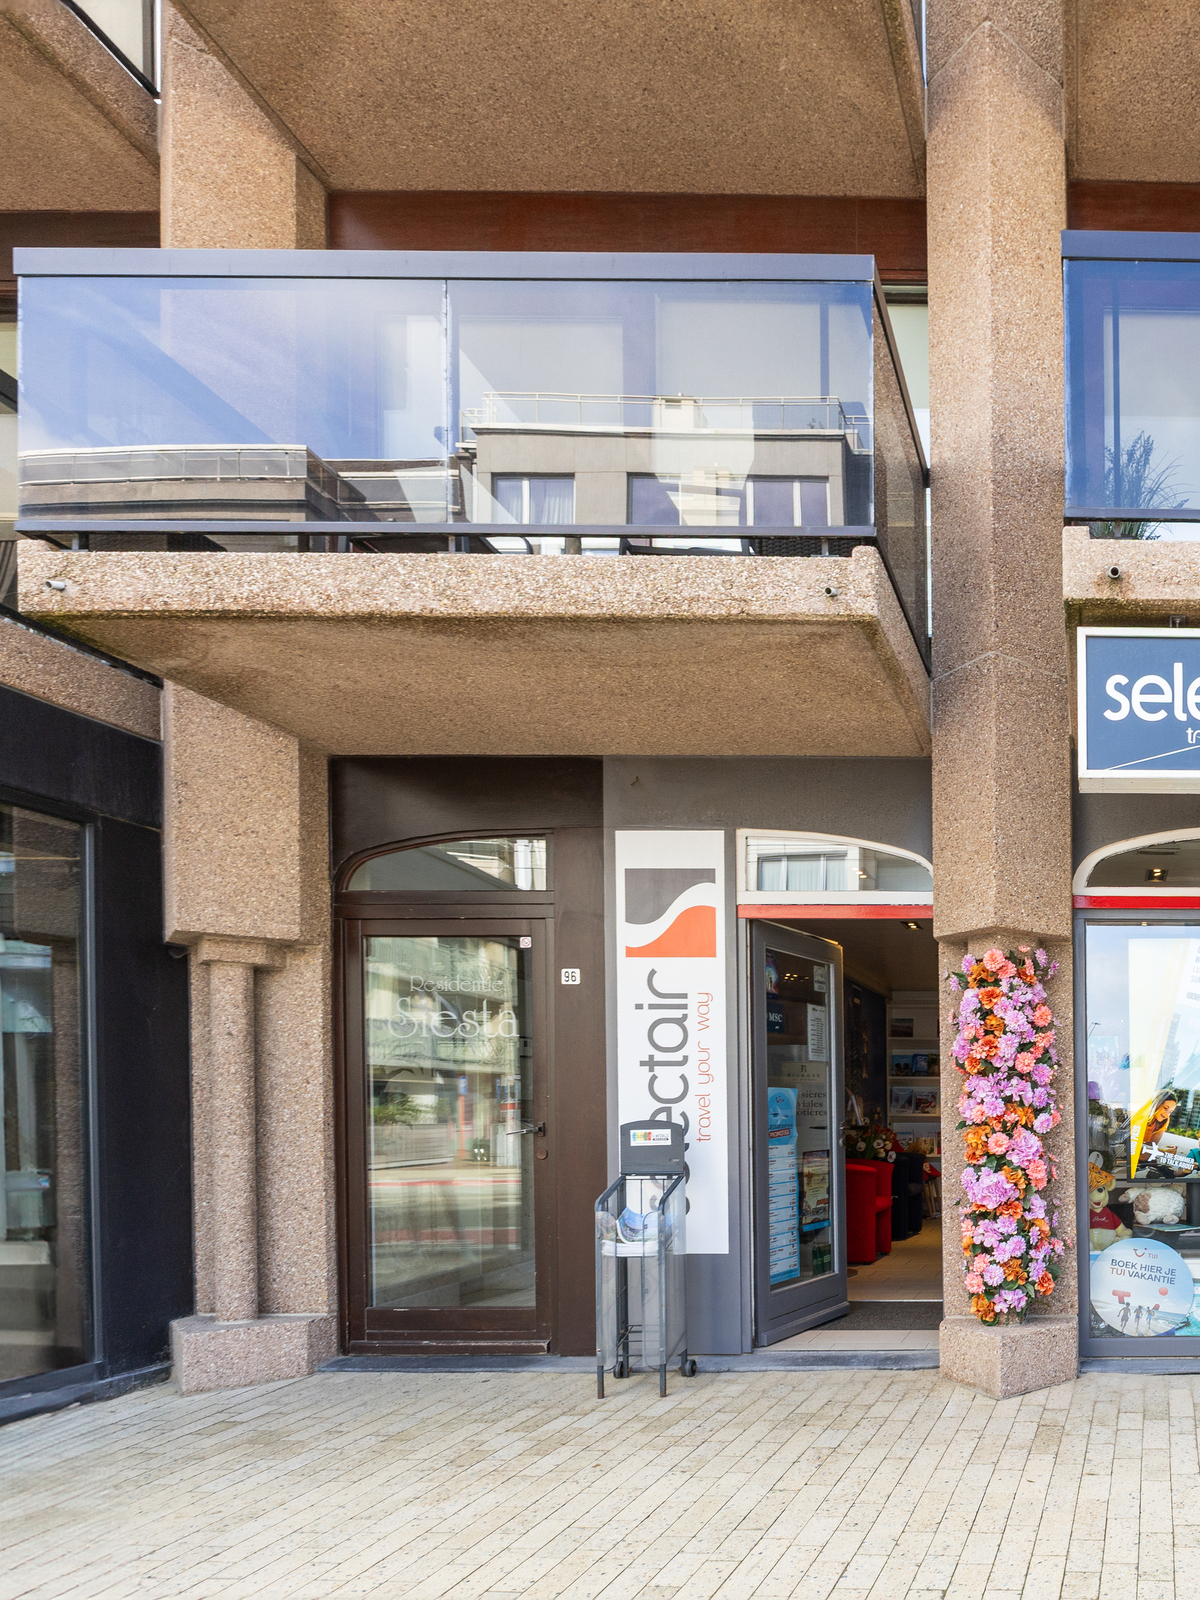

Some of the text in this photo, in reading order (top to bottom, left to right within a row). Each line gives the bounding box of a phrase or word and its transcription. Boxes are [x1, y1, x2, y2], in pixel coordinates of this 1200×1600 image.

[410, 975, 503, 992] Residentie
[564, 971, 577, 983] 96
[388, 995, 520, 1039] Siesta
[768, 1012, 783, 1023] MSC
[695, 992, 714, 1142] travel your way
[1131, 1125, 1141, 1141] PASS
[1160, 1156, 1195, 1171] TO TALK ABOUT
[1110, 1259, 1177, 1277] BOEK HIER JE
[1110, 1267, 1176, 1285] TUI VAKANTIE
